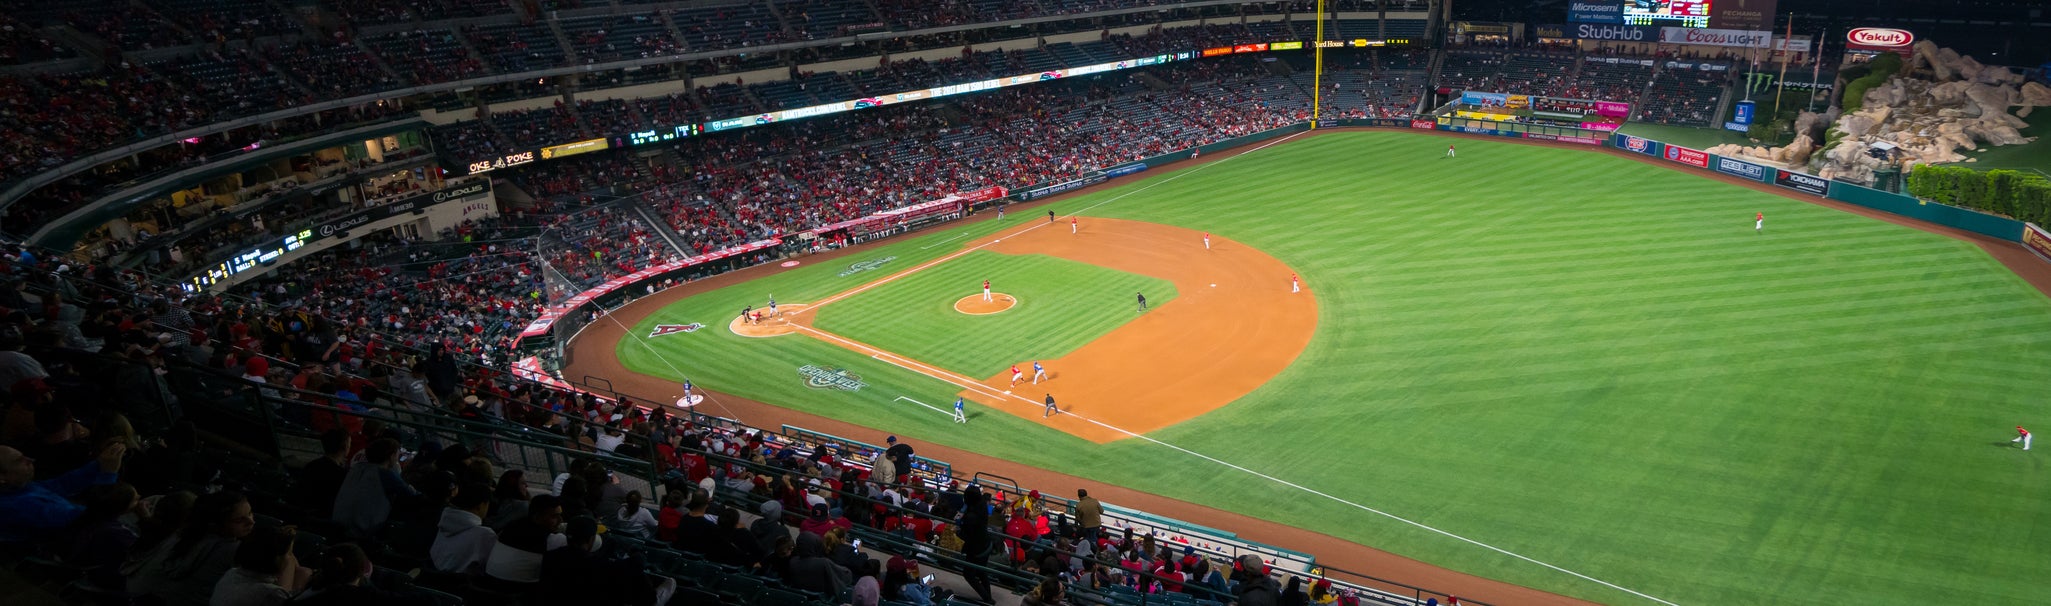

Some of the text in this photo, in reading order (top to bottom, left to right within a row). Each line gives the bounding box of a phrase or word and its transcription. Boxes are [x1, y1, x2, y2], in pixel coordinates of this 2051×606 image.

[1578, 24, 1643, 41] StubHub
[1686, 28, 1726, 43] Coors
[1727, 34, 1764, 44] LIGHT
[1859, 32, 1902, 42] Yakult
[1772, 80, 1832, 90] MONSTER
[506, 151, 533, 164] POKE
[1680, 157, 1704, 165] AAA.com
[1790, 174, 1826, 188] YOKOHAMA
[445, 185, 484, 198] LEXUS
[463, 203, 489, 216] ANGELS
[333, 214, 369, 231] LEXUS
[202, 276, 208, 284] E
